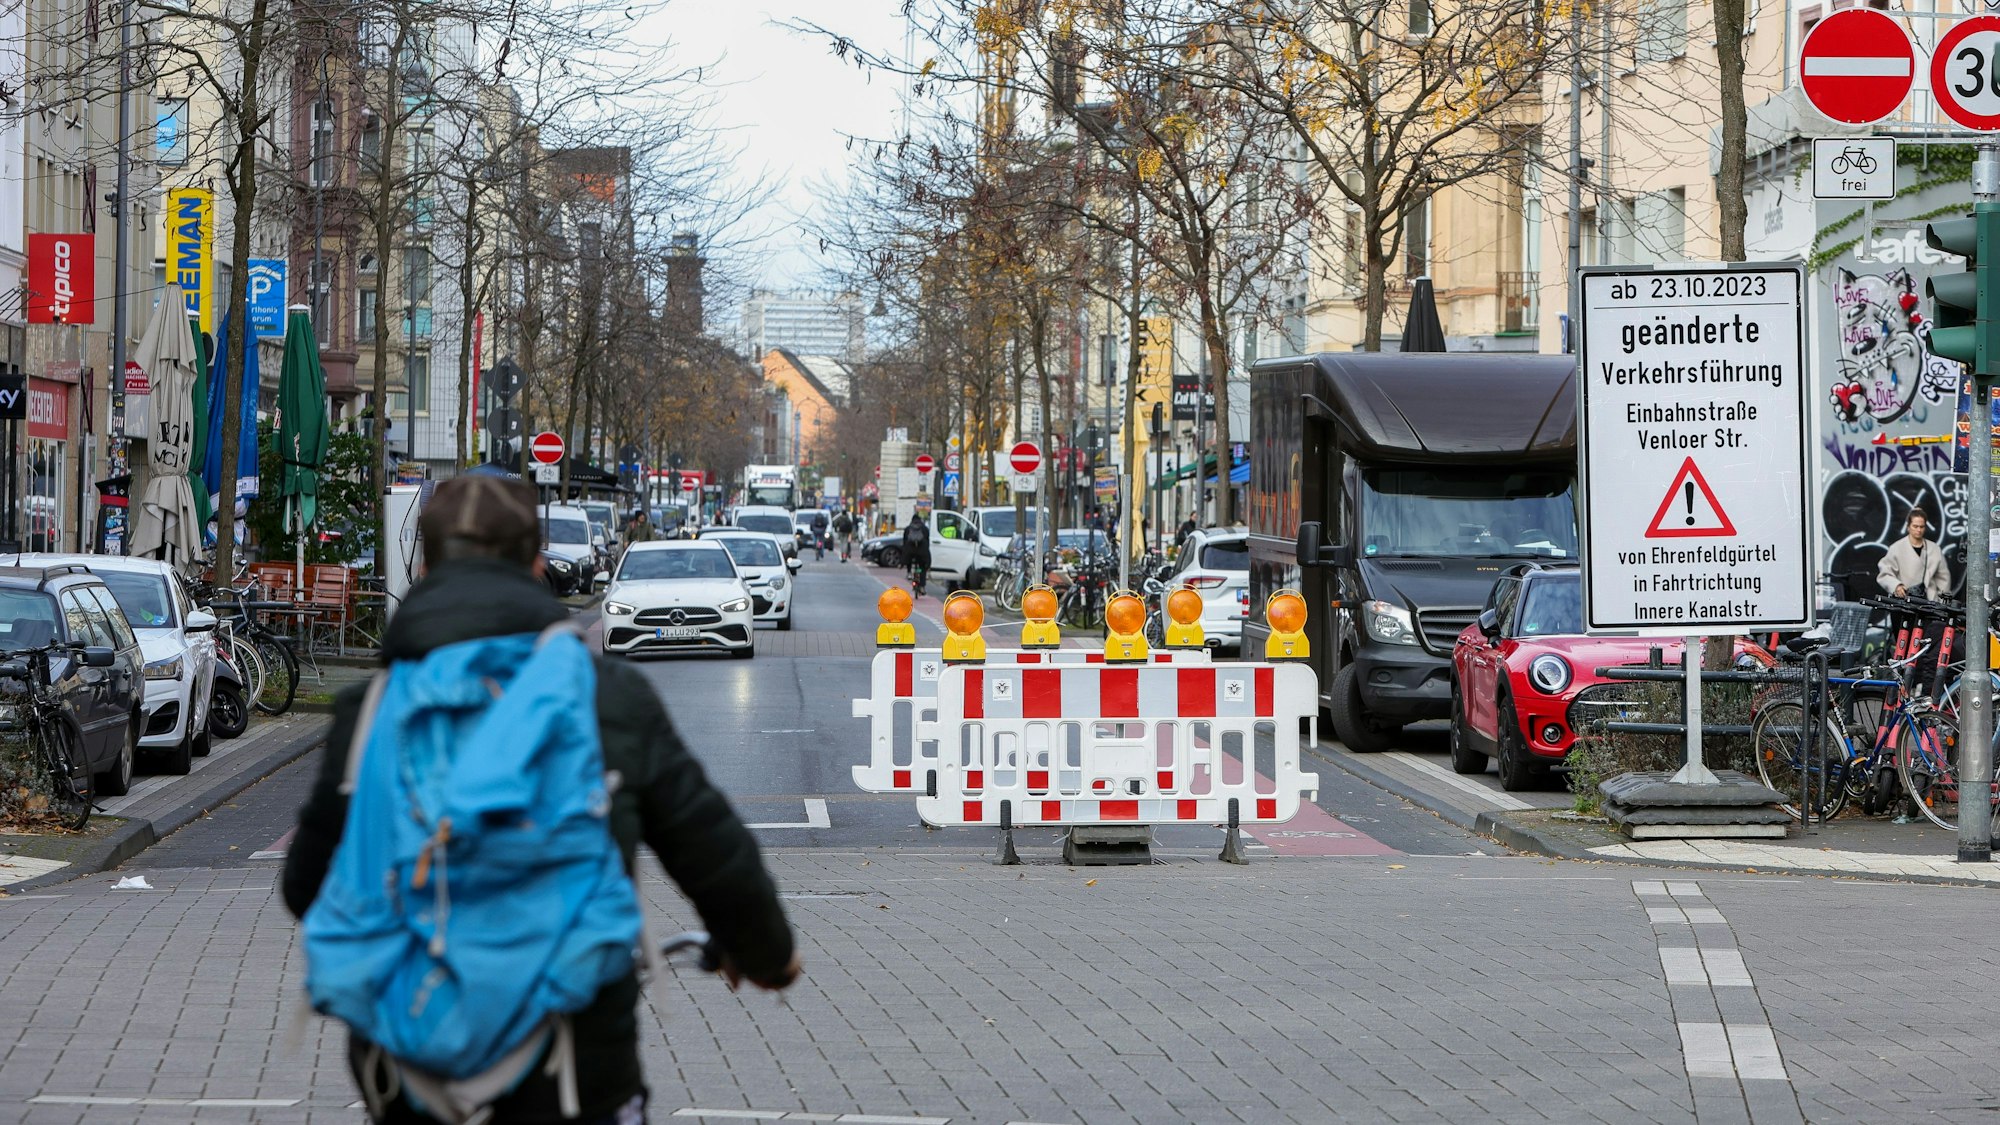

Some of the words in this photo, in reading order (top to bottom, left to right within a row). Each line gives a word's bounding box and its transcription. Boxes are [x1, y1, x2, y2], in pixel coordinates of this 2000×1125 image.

[1954, 47, 2000, 98] 3
[1842, 178, 1866, 191] frei
[177, 198, 201, 312] EEMAN
[48, 241, 74, 317] tipico
[1611, 280, 1637, 299] ab
[1651, 276, 1766, 298] 23.10.2023
[251, 306, 278, 314] rthonia
[1622, 313, 1760, 354] geänderte
[1601, 359, 1782, 388] Verkehrsführung
[1627, 401, 1757, 423] Einbahnstraße
[1638, 429, 1707, 450] Venloer
[1715, 428, 1748, 448] Str.
[1618, 551, 1646, 565] von
[1652, 545, 1776, 567] Ehrenfeldgürtel
[1634, 575, 1647, 592] in
[1653, 573, 1761, 594] Fahrtrichtung
[1635, 602, 1683, 619] Innere
[1689, 599, 1762, 618] Kanalstr.
[686, 628, 699, 636] 293
